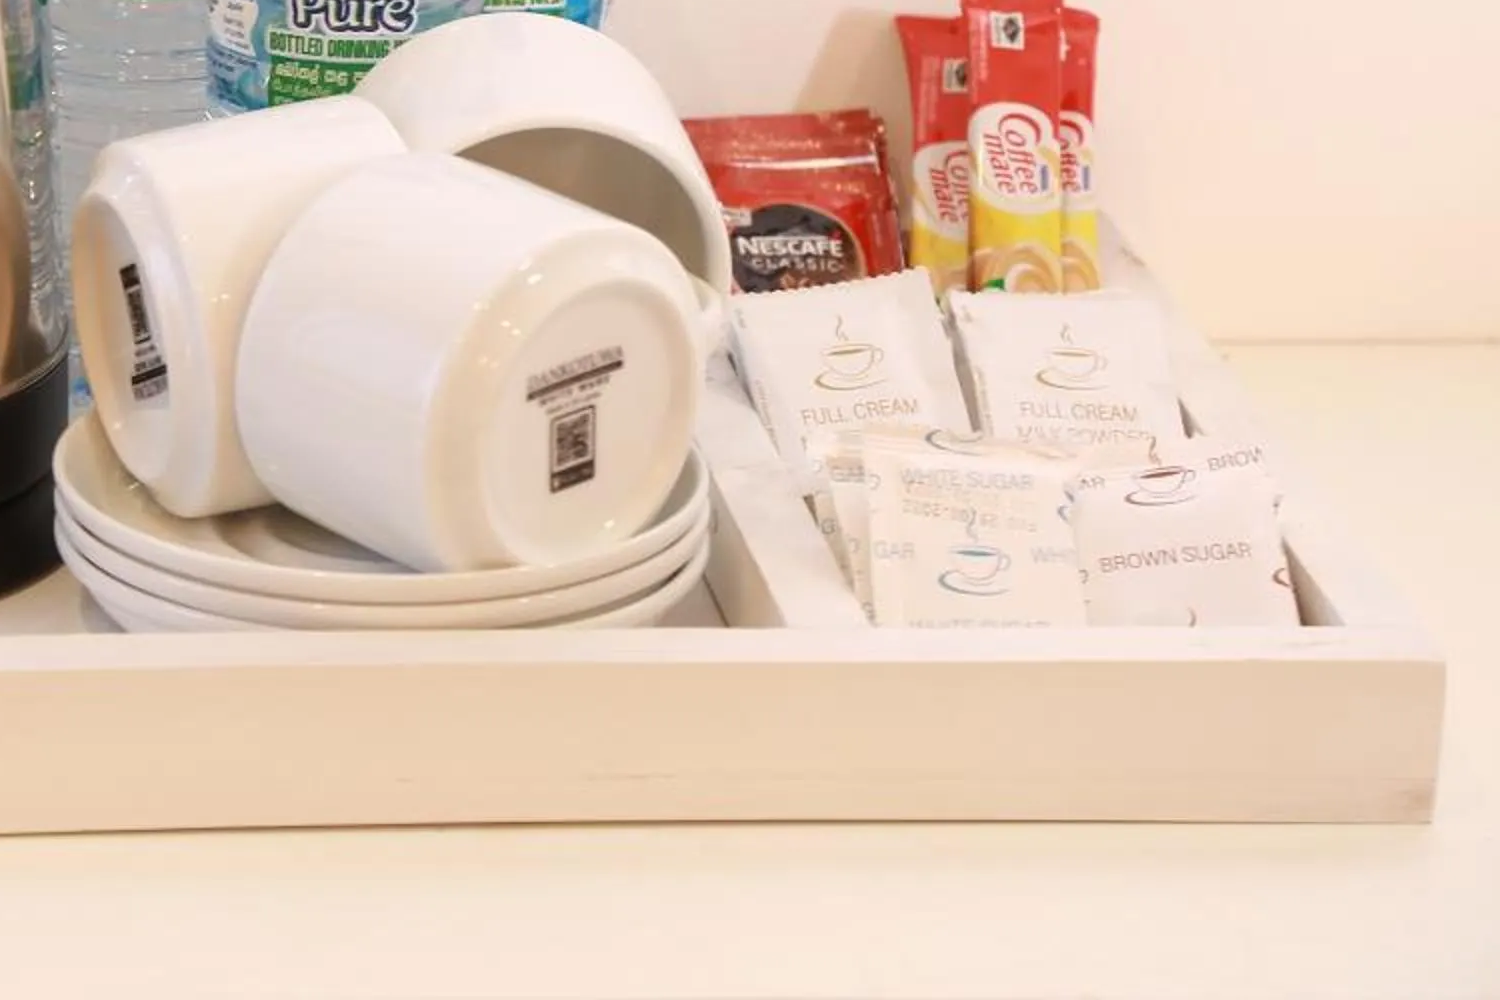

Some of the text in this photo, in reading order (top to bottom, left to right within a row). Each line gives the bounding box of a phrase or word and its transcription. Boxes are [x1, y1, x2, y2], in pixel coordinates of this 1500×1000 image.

[269, 31, 323, 57] BOTTLED
[327, 38, 391, 59] DRINKING
[983, 132, 1017, 195] mate
[999, 112, 1042, 194] Coffee
[752, 257, 840, 273] CLASSIC
[801, 399, 918, 425] FULL CREAM
[1020, 401, 1138, 422] FULL CREAM
[1208, 447, 1263, 472] BROW
[901, 469, 1034, 490] WHITE SUGAR
[873, 540, 916, 559] GAR
[1100, 542, 1252, 574] BROWN SUGAR
